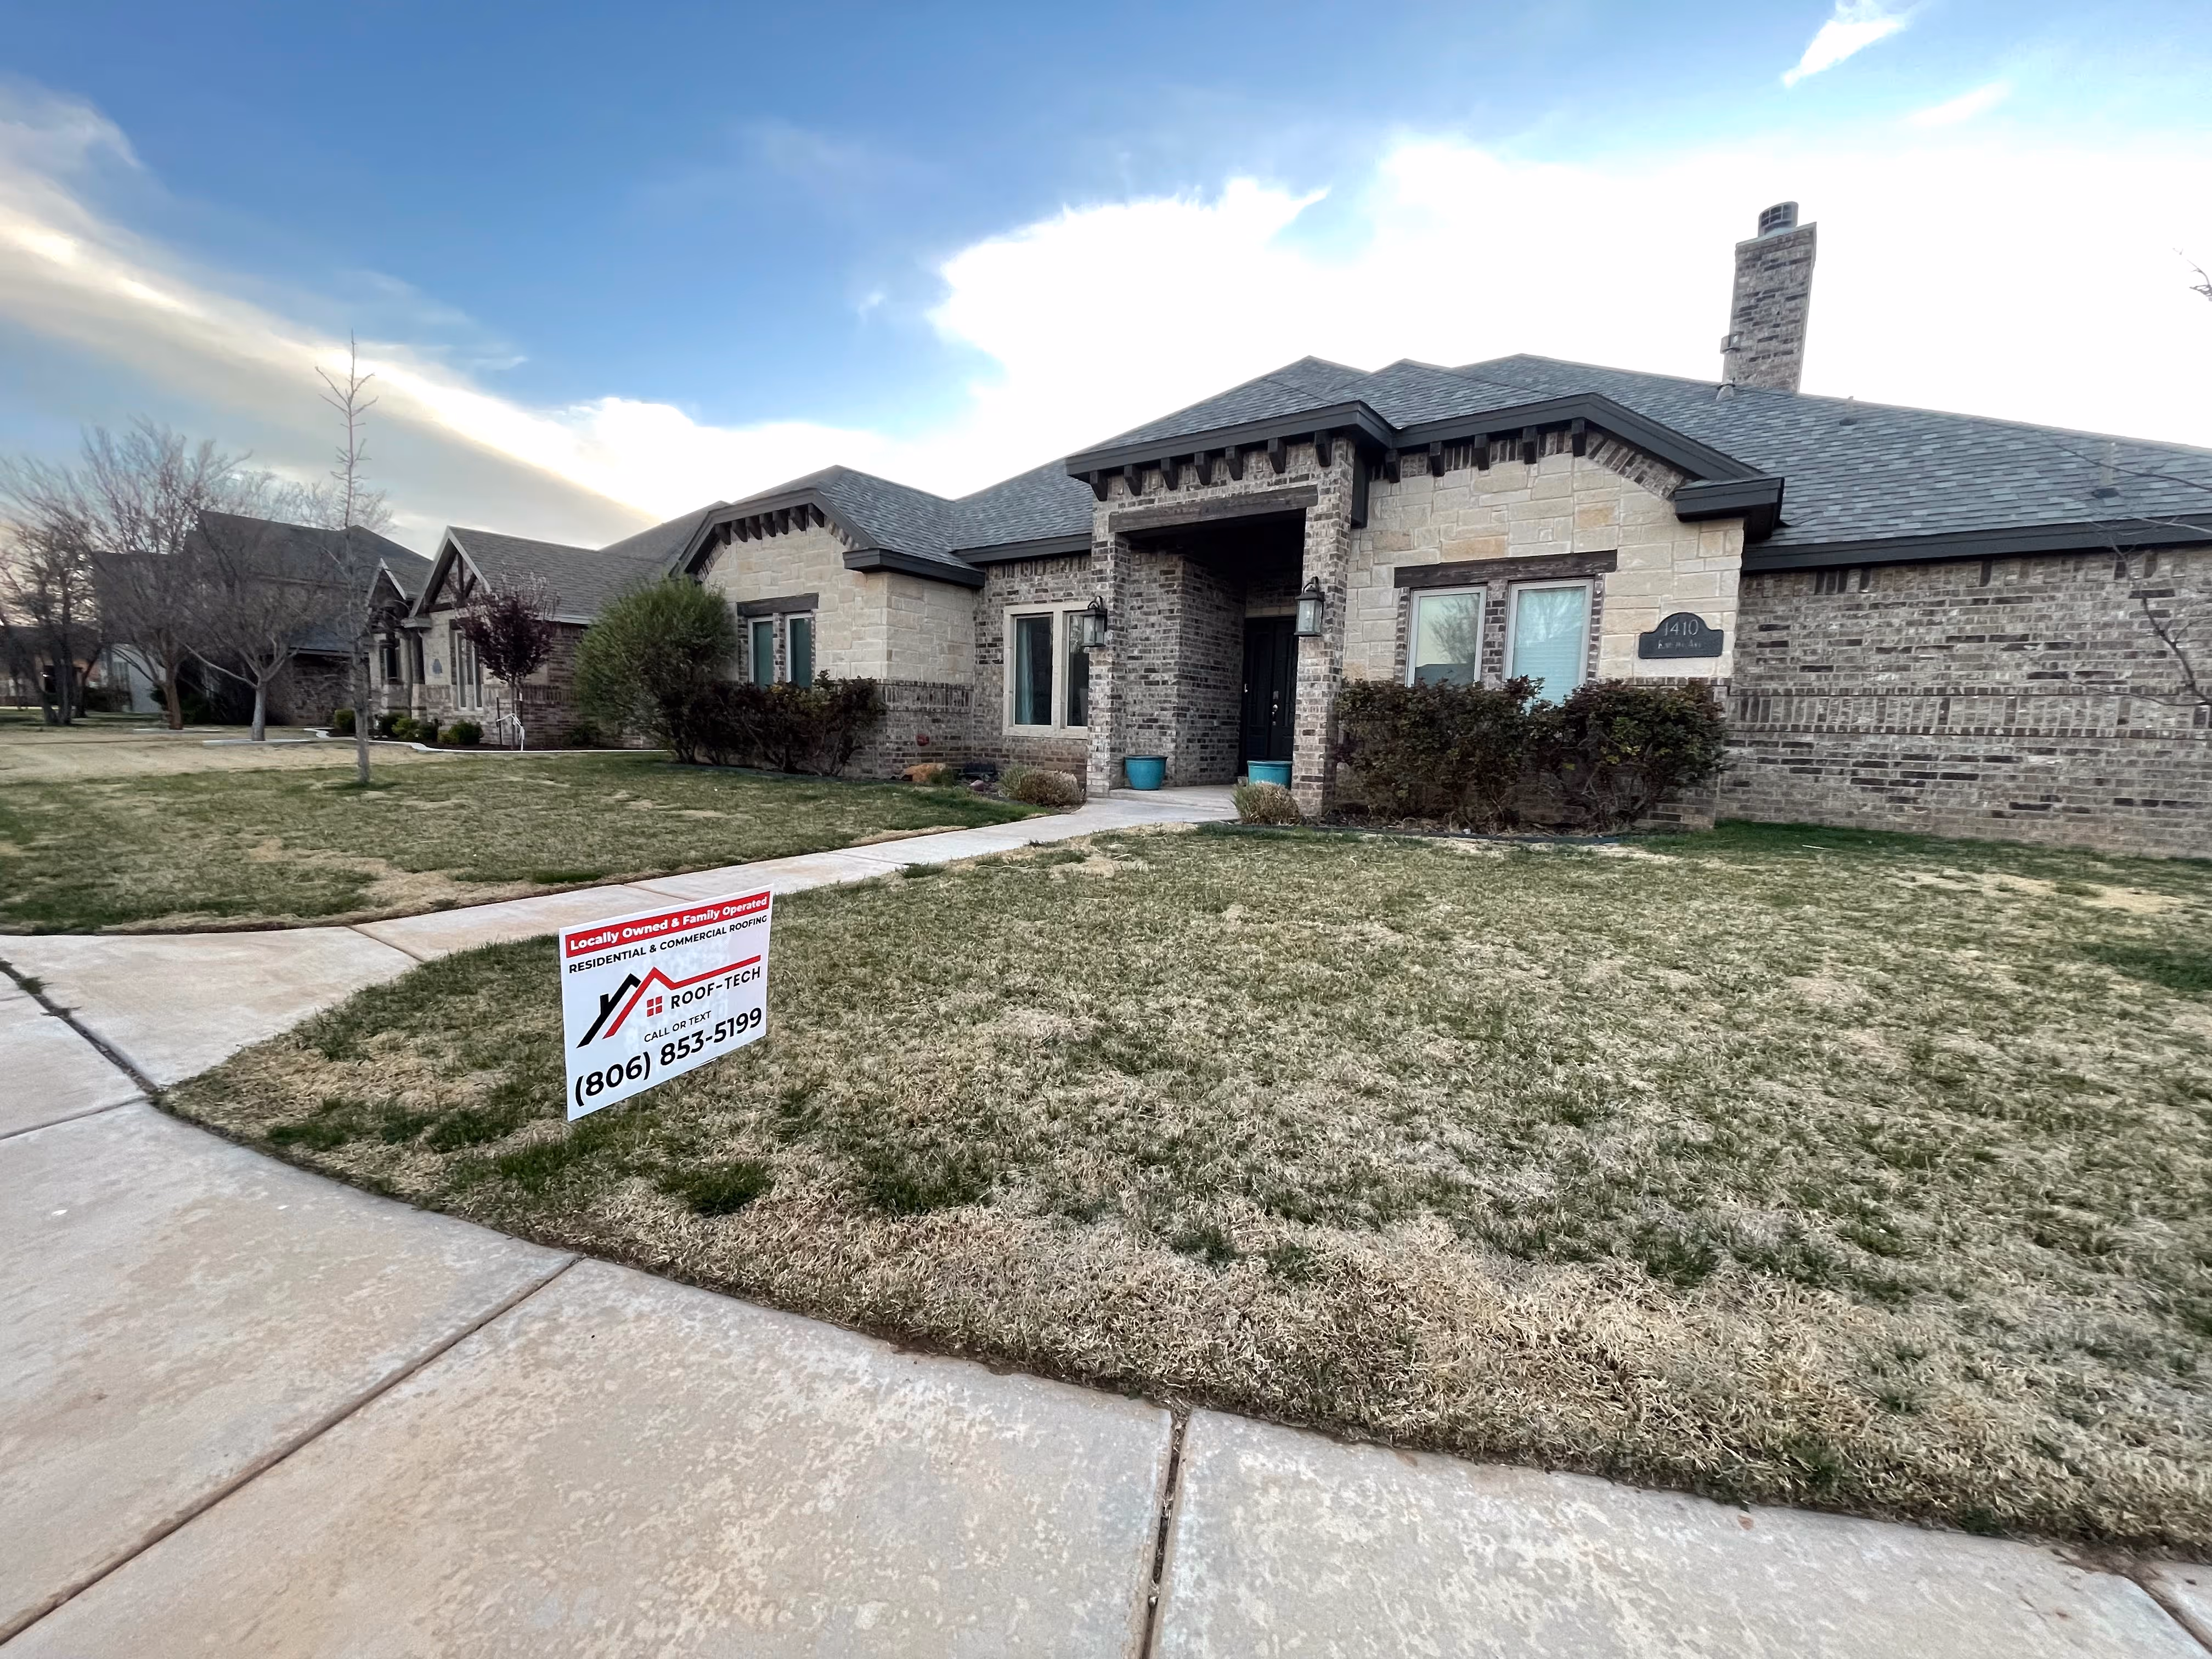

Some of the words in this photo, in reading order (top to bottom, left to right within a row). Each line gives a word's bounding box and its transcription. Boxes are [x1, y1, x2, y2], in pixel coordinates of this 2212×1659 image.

[1663, 619, 1699, 636] 1410
[569, 947, 646, 973] RESIDENTIAL
[650, 944, 656, 953] &
[660, 929, 726, 950] COMMERCIAL
[730, 915, 767, 932] ROOFING
[571, 931, 619, 951] Locally
[623, 919, 668, 939] Owned
[671, 918, 679, 928] &
[682, 910, 720, 925] Family
[723, 896, 767, 916] Operated
[671, 966, 760, 1009] ROOF-TECH
[644, 1027, 669, 1042] CALL
[673, 1020, 686, 1032] OR
[689, 1011, 711, 1026] TEXT
[575, 1052, 651, 1107] (806)
[660, 1007, 761, 1065] 853-5199
